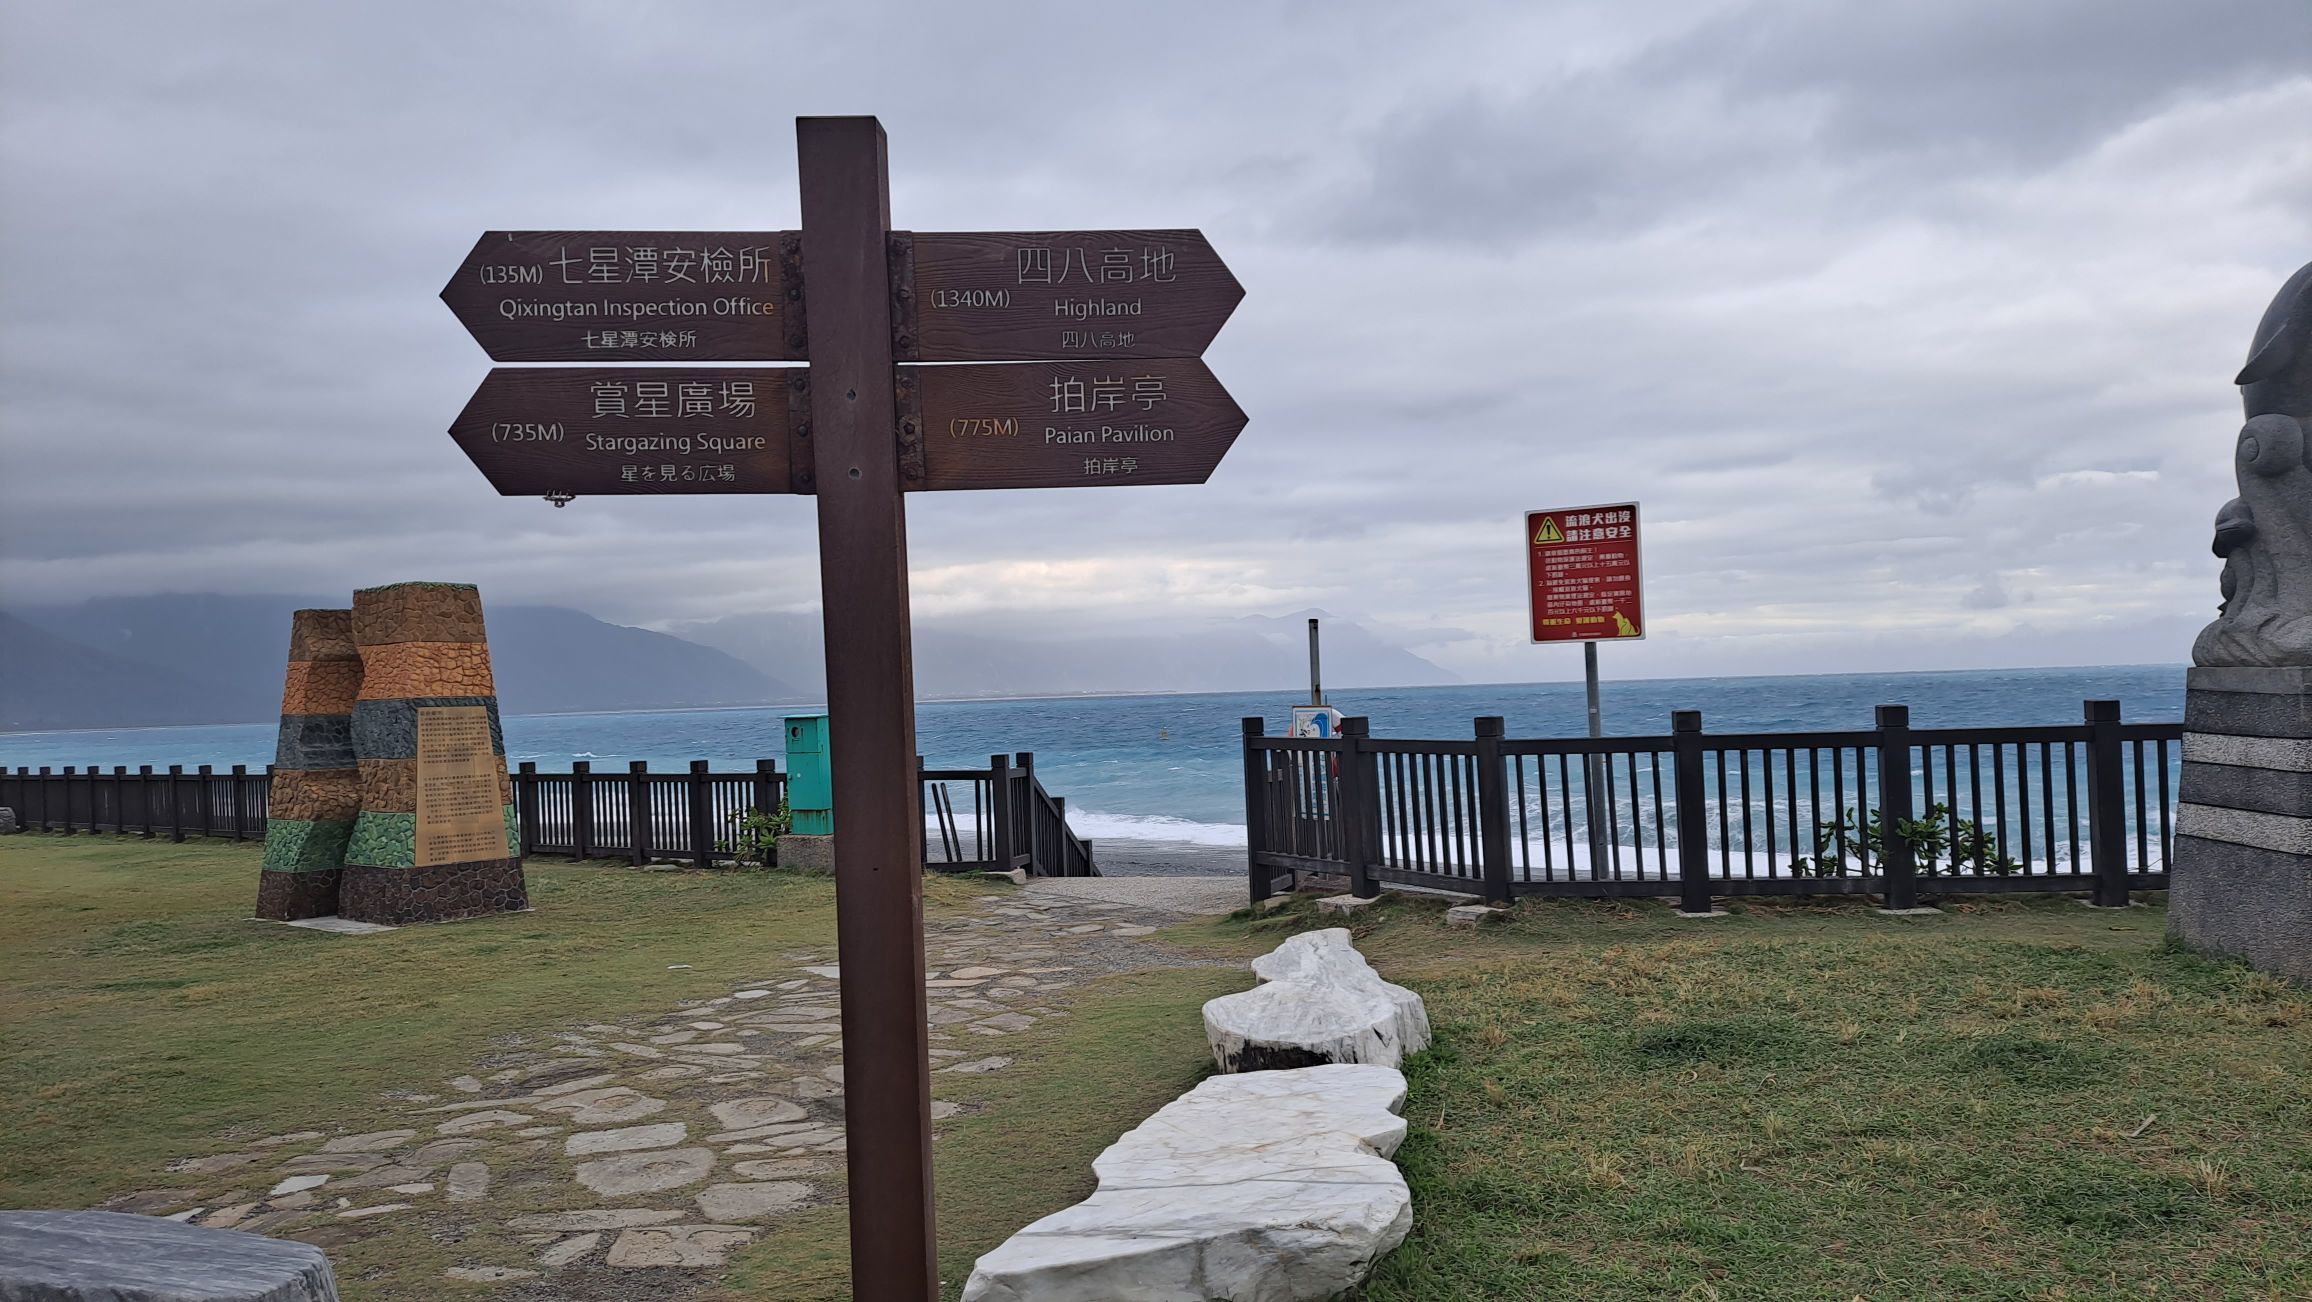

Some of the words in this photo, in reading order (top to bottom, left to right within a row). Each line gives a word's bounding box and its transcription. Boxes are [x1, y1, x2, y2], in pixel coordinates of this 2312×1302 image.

[480, 264, 543, 284] (135M)
[549, 246, 770, 284] 七星潭安檢所
[1017, 246, 1177, 284] 四八高地
[931, 289, 1010, 308] (1340M)
[500, 299, 597, 320] Qixingtan
[604, 298, 707, 320] Inspection
[713, 298, 774, 315] Office
[1055, 298, 1142, 320] Highland
[581, 330, 697, 349] 七星潭安検所
[1062, 331, 1136, 349] 四八高地
[590, 381, 756, 418] 賞星廣場
[1049, 374, 1167, 413] 拍岸亭
[492, 422, 564, 442] (735M)
[950, 418, 1019, 437] (775M)
[1045, 427, 1095, 444] Paian
[1101, 425, 1174, 443] Pavilion
[585, 434, 691, 454] Stargazing
[697, 433, 766, 454] Square
[620, 464, 736, 482] 星を見る広場
[1083, 457, 1138, 475] 拍岸亭
